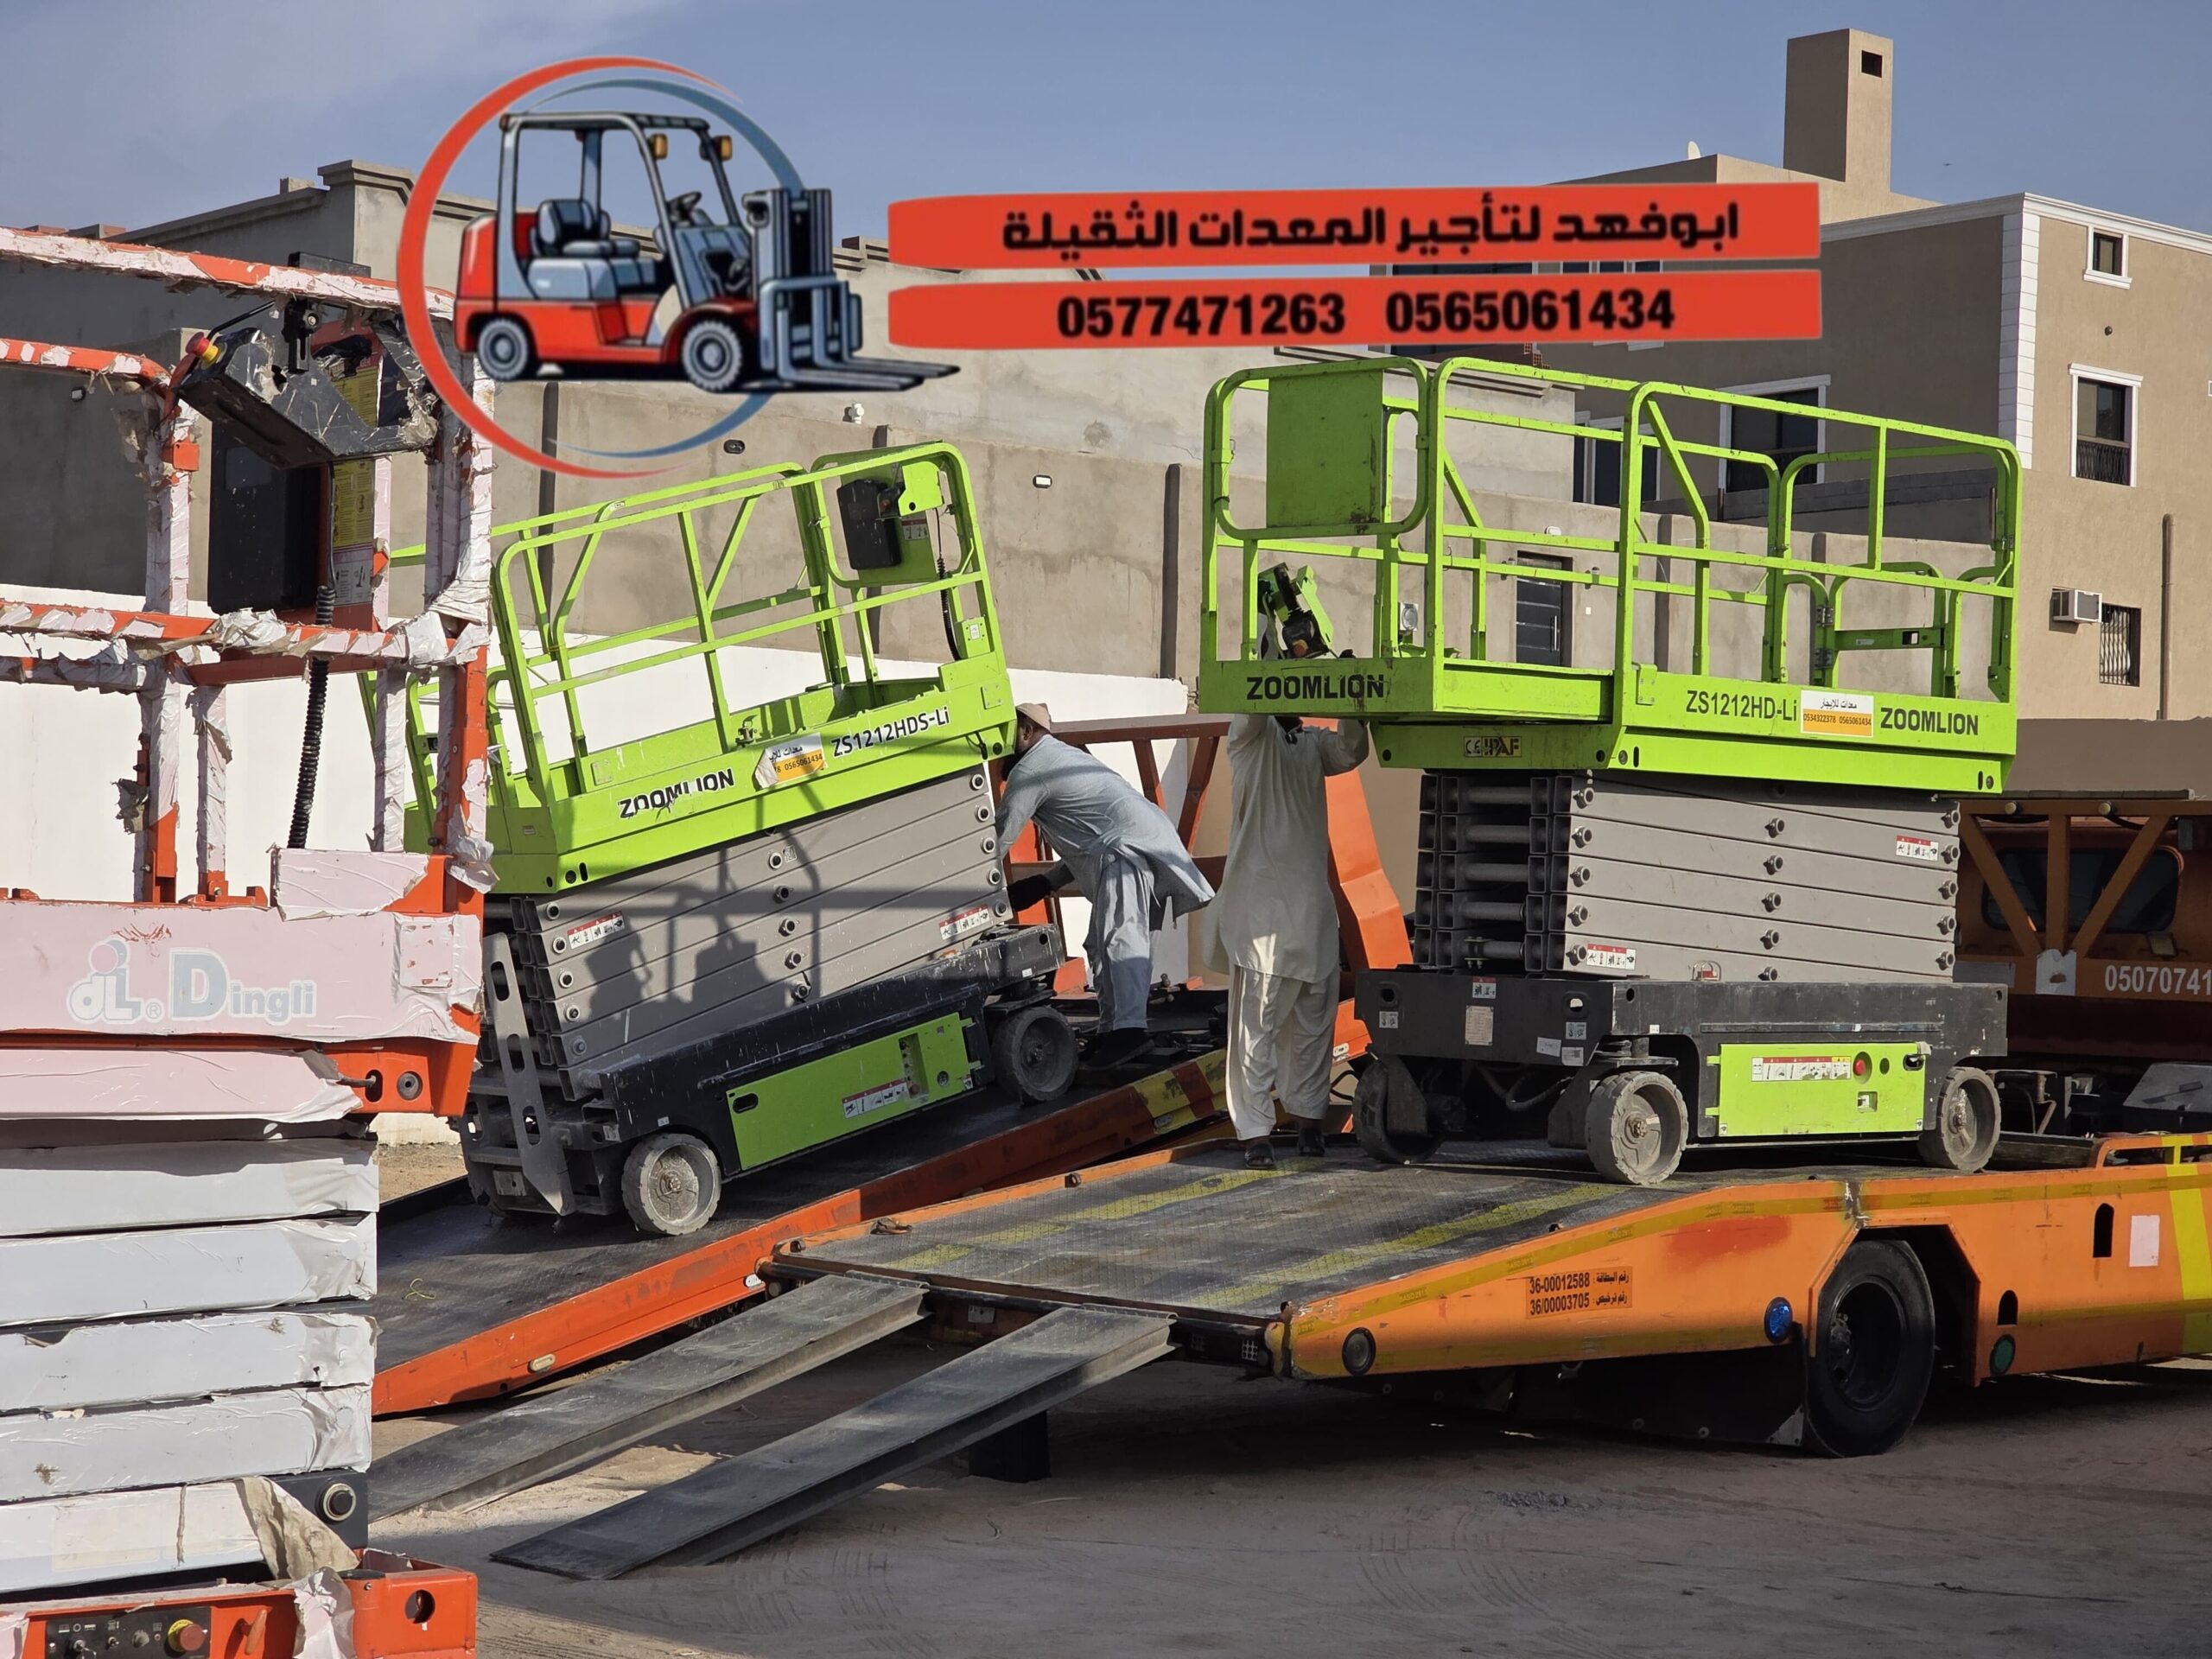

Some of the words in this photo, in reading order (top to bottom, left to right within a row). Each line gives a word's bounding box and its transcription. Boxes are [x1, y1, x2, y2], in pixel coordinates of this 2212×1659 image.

[1246, 673, 1384, 700] ZOOMLION
[1686, 690, 1797, 721] ZS1212HD-Li
[830, 705, 950, 757] ZS1212HDS-Li
[1839, 715, 1872, 727] 0565061434
[1880, 707, 1979, 735] ZOOMLION
[784, 745, 804, 756] معدات
[784, 753, 823, 771] 0565061434
[169, 949, 316, 1025] Dingli
[1529, 1271, 1591, 1294] 36-00012588
[1529, 1292, 1590, 1315] 36/00003705
